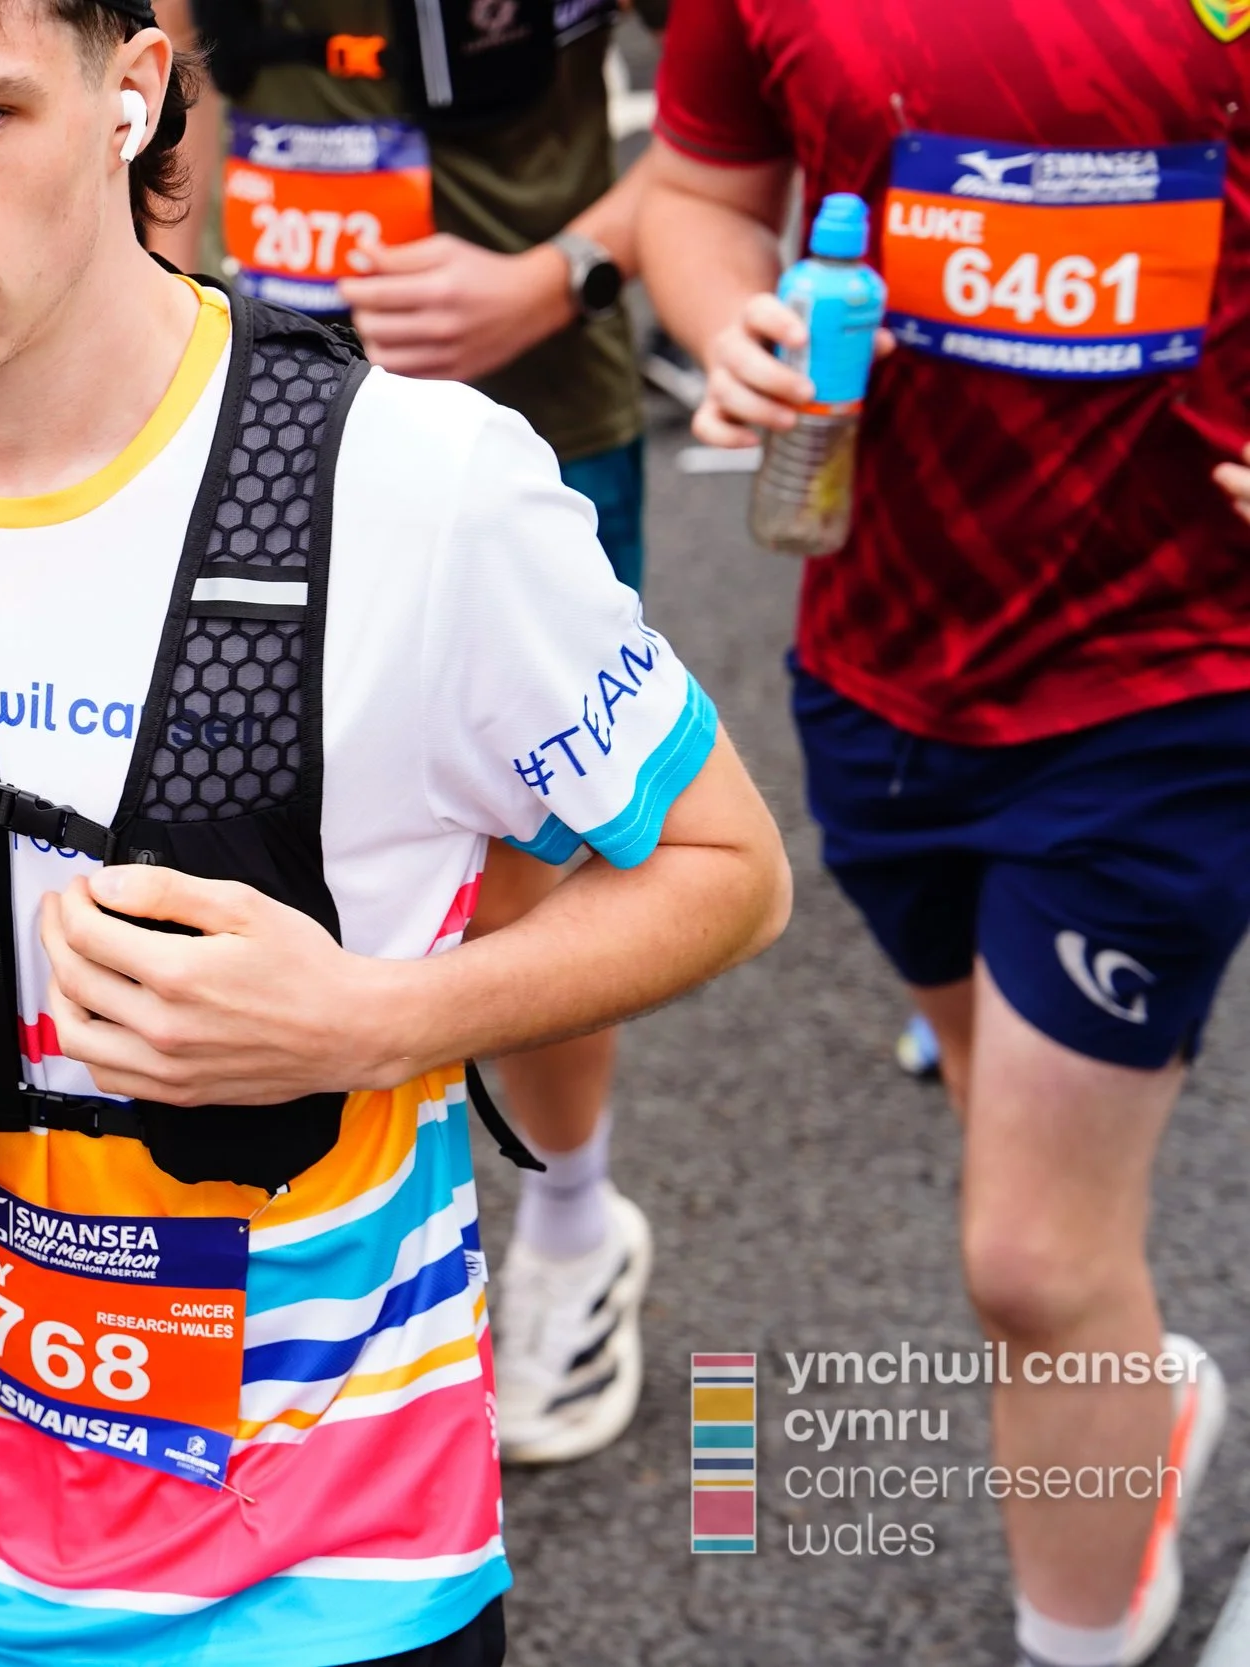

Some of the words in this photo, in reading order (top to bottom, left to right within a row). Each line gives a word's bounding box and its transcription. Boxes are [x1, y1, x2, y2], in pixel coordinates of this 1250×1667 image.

[251, 203, 382, 273] 2073
[888, 202, 985, 245] LUKE
[943, 247, 1140, 327] 6461
[14, 1227, 59, 1255] Half
[56, 1242, 161, 1270] Marathon
[16, 1206, 159, 1250] SWANSEA
[50, 1256, 103, 1275] MARATHON
[96, 1311, 178, 1335] RESEARCH
[181, 1322, 234, 1339] WALES
[170, 1303, 234, 1319] CANCER
